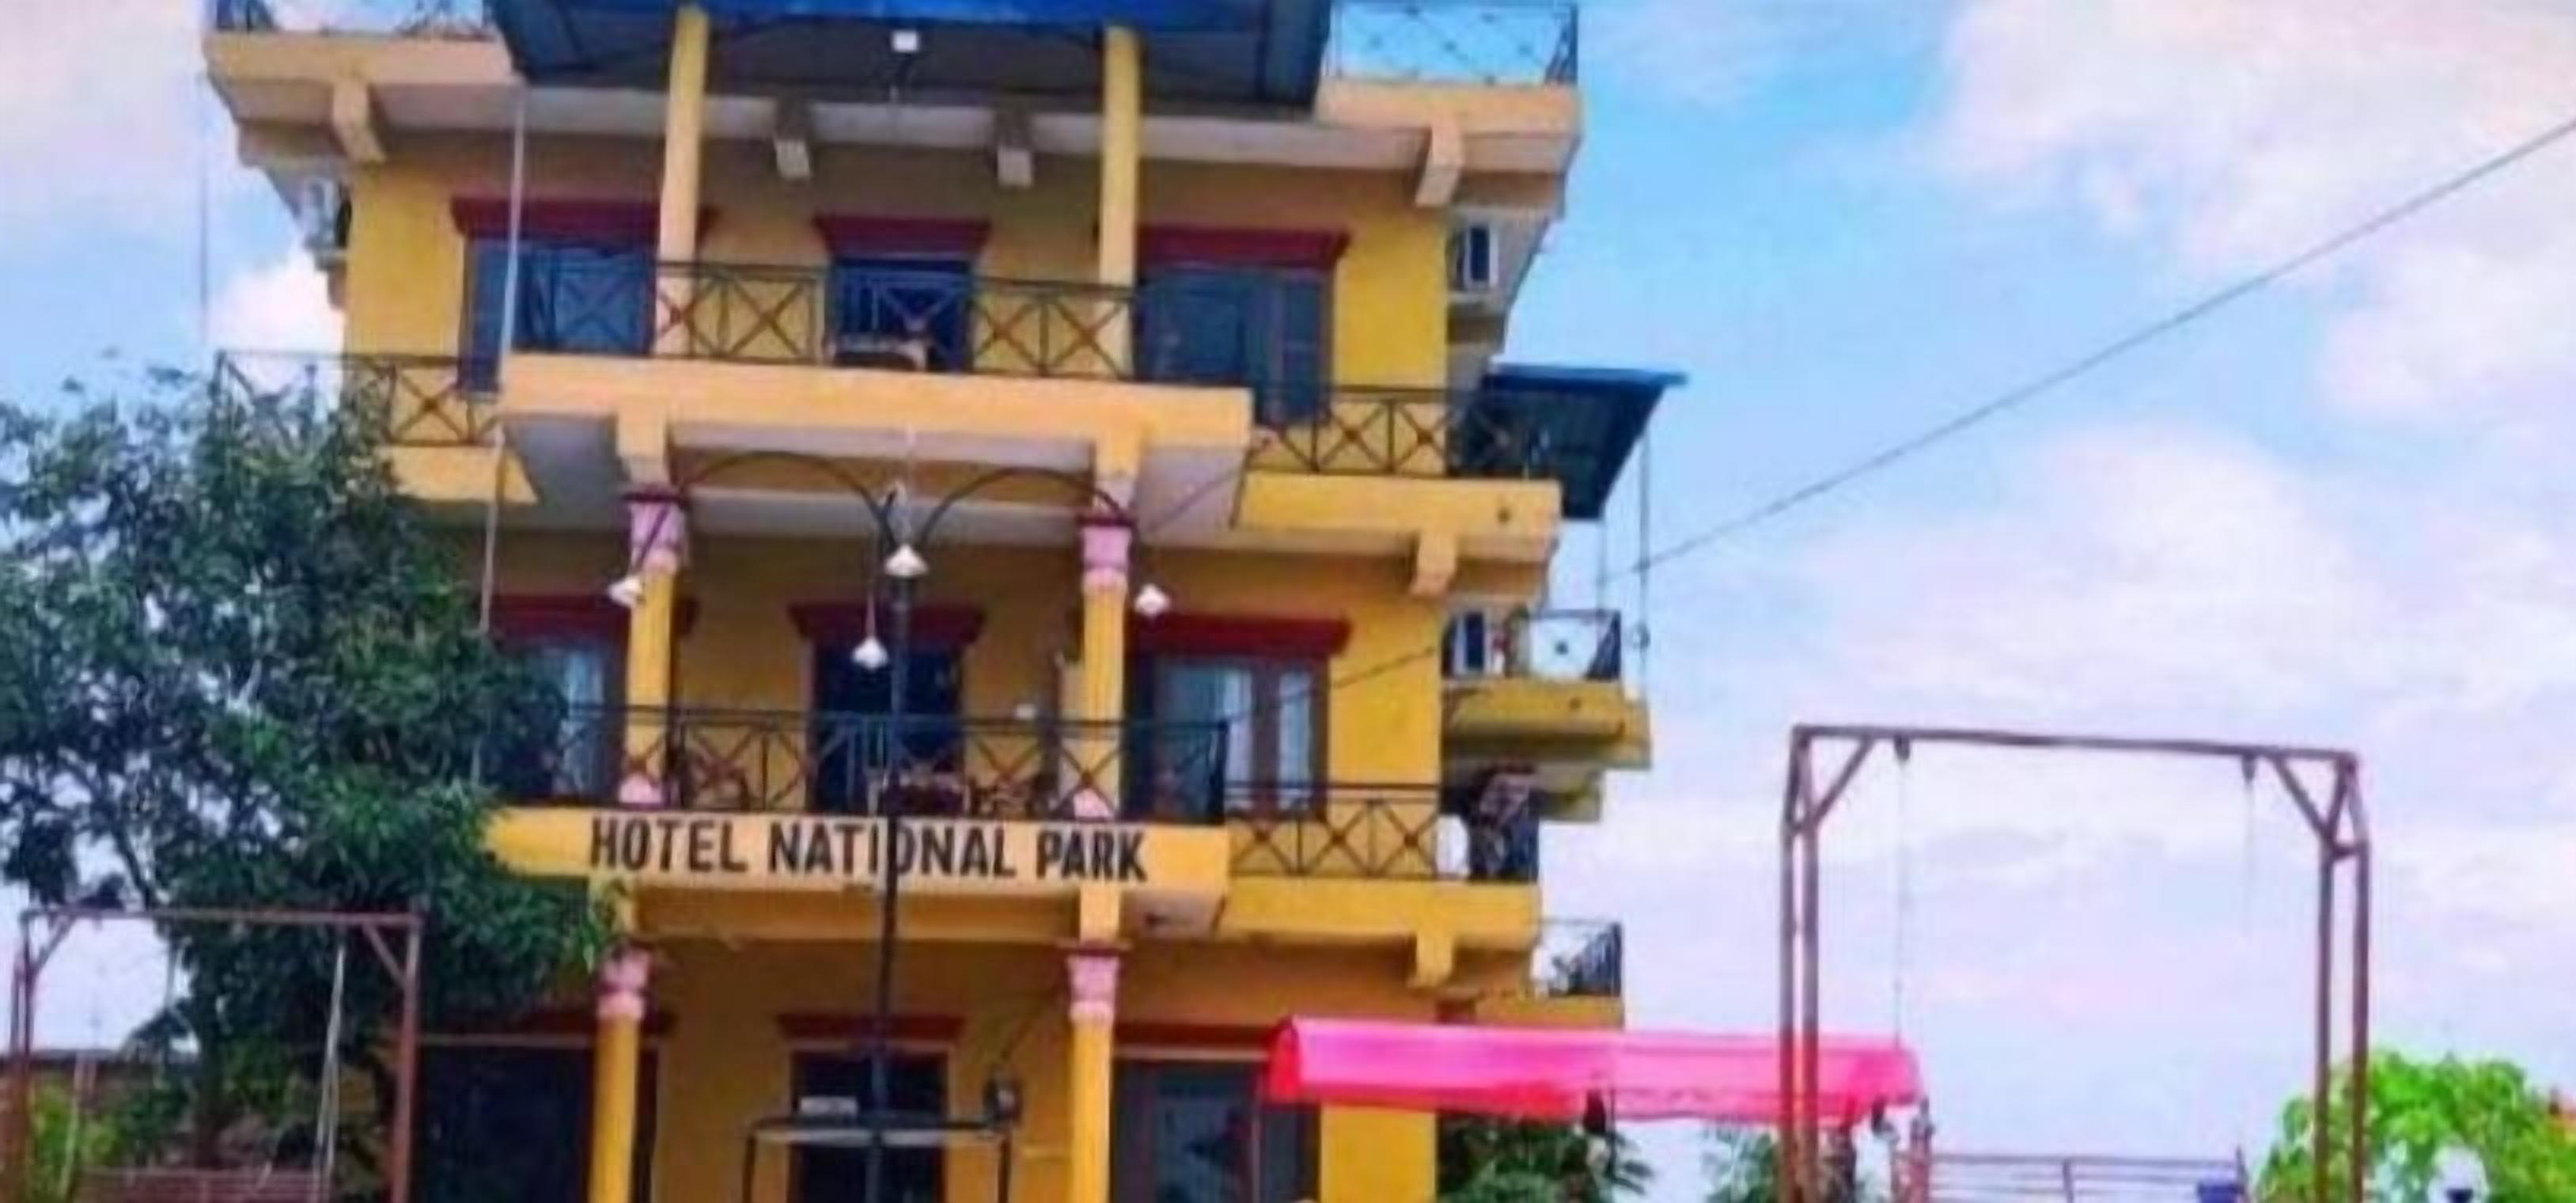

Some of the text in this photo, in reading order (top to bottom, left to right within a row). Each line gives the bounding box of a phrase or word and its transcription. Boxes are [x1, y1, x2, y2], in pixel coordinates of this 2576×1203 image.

[589, 817, 1147, 882] HOTEL NATIONAL PARK
